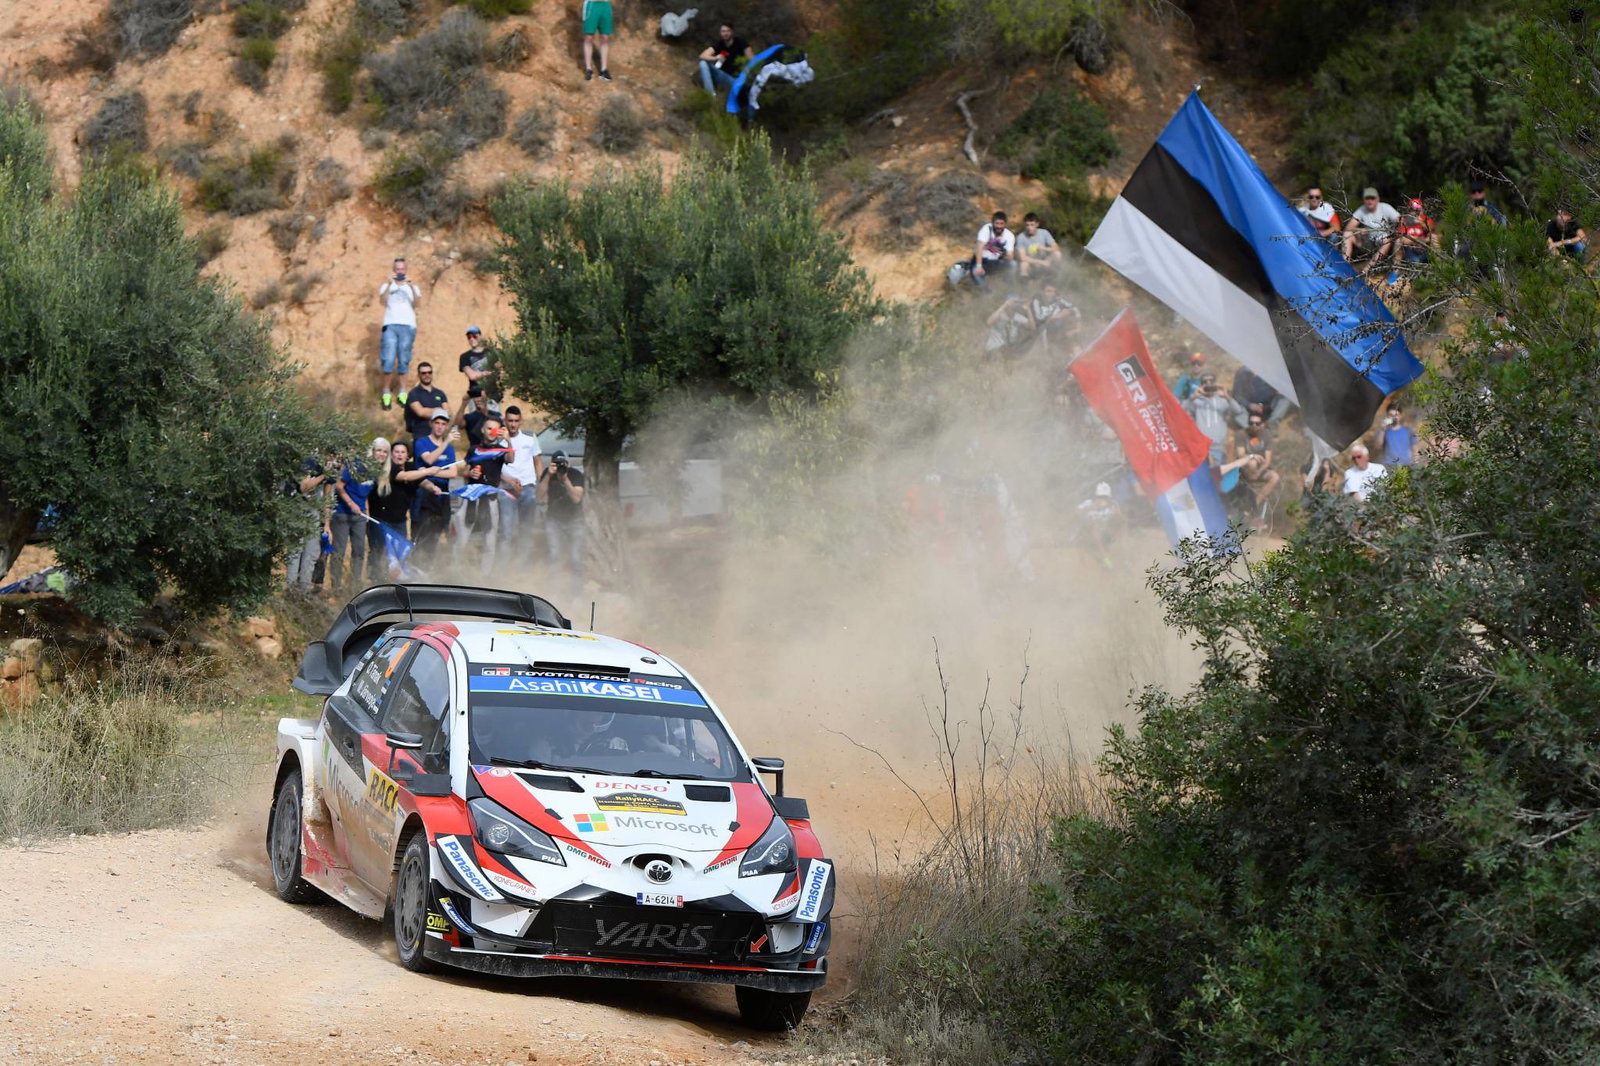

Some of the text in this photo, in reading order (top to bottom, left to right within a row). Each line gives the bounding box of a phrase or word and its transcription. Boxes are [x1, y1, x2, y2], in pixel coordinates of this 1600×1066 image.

[1117, 362, 1147, 407] GR
[514, 670, 574, 679] TOYOTA
[633, 677, 683, 690] Racing
[595, 781, 668, 793] DENSO
[615, 795, 660, 804] RallyRACC
[613, 815, 718, 838] Microsoft
[541, 854, 562, 864] PIAA
[566, 845, 612, 869] DMG MORI
[703, 856, 738, 875] DMG MORI
[444, 841, 494, 898] Panasonic
[742, 869, 759, 877] PIAA
[645, 895, 675, 905] A-6214
[800, 865, 826, 918] Panasonic
